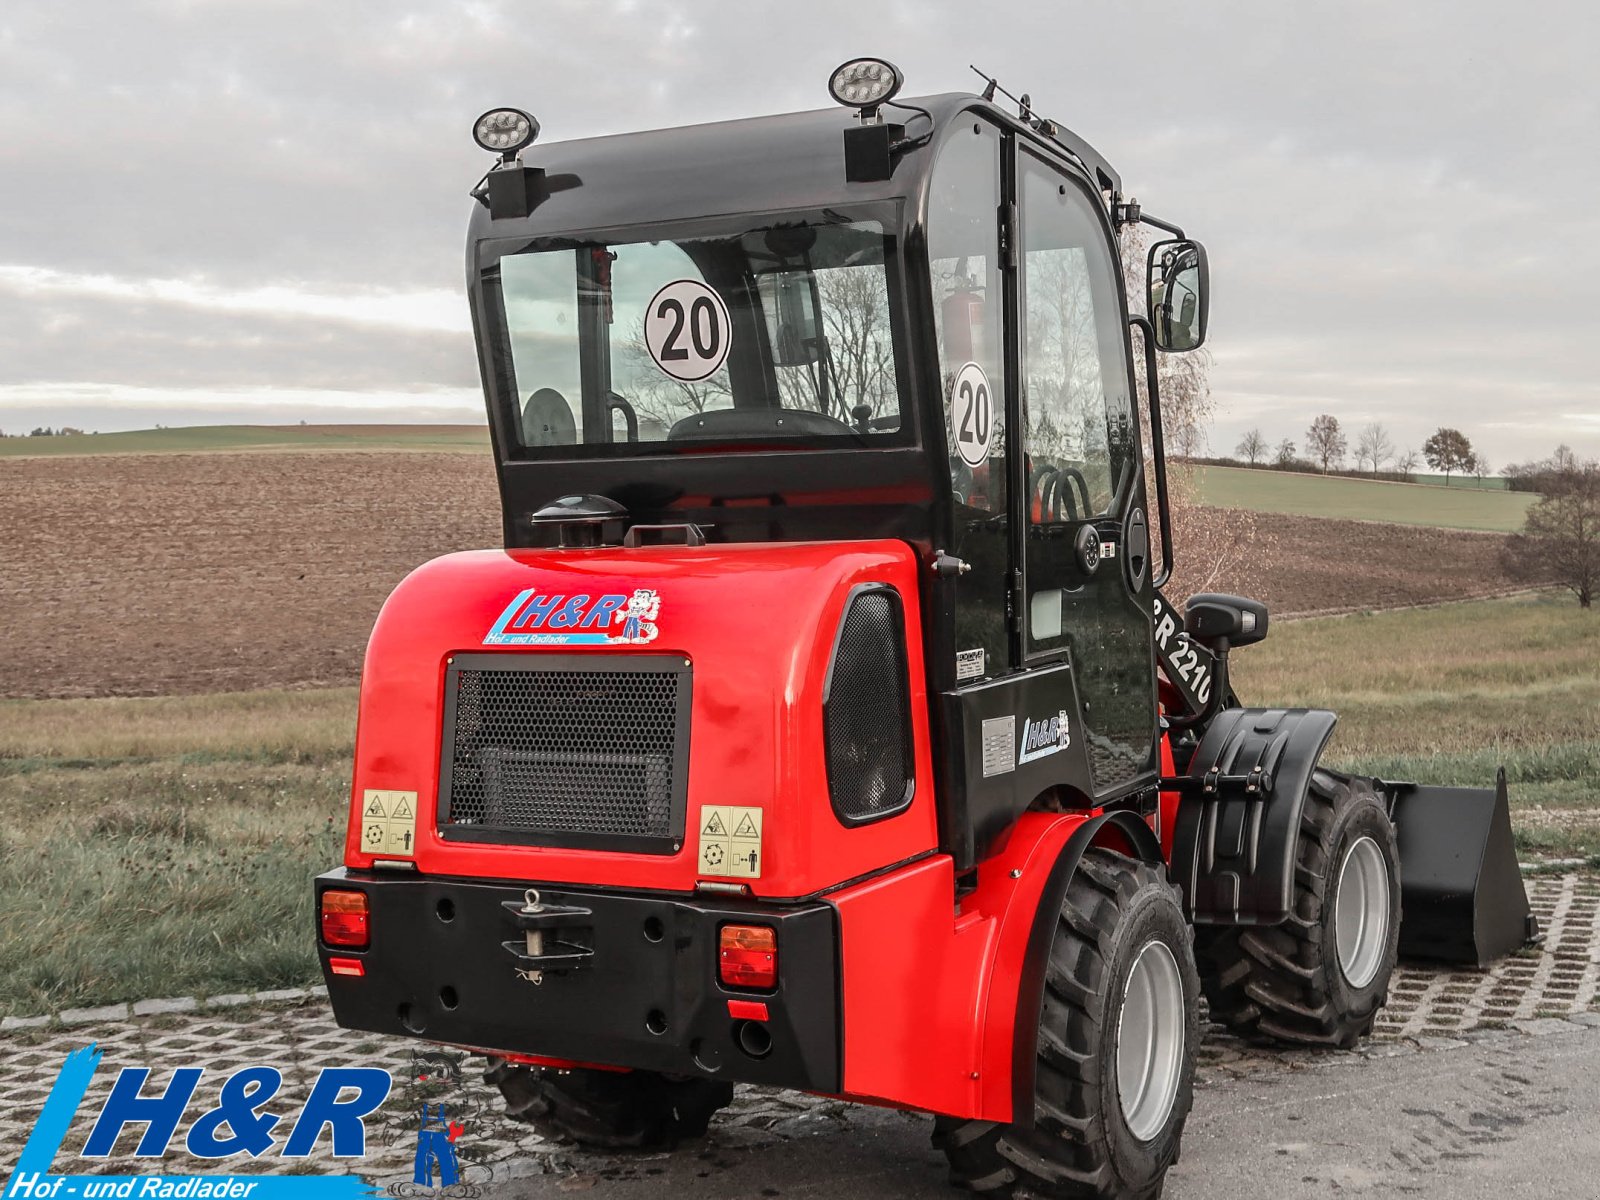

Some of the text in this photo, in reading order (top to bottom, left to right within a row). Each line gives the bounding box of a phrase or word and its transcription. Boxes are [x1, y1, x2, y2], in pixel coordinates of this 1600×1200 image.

[657, 296, 720, 361] 20
[958, 379, 989, 446] 20
[512, 594, 628, 628] H&R
[510, 633, 531, 644] und
[529, 633, 570, 644] Radlader
[1027, 716, 1059, 750] H&R
